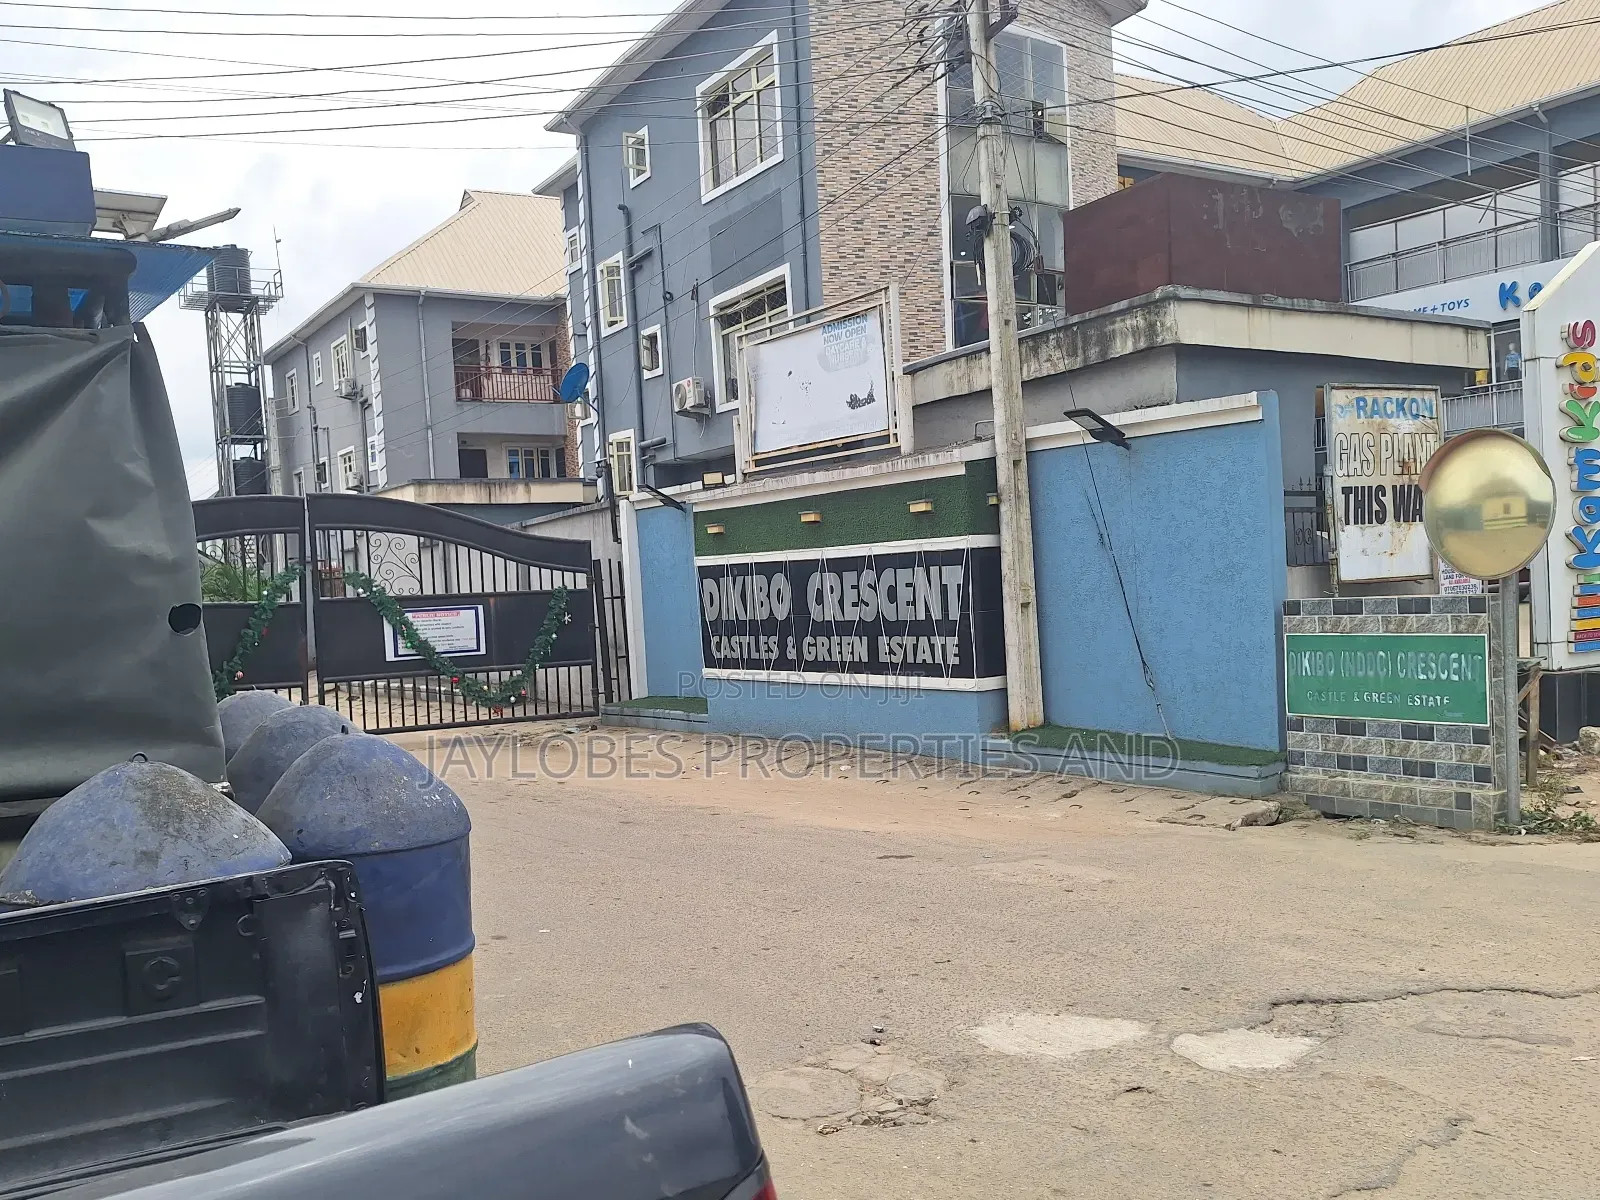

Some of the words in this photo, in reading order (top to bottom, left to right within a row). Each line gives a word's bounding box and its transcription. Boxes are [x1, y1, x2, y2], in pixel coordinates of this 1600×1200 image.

[1441, 298, 1470, 313] TOYS
[822, 313, 868, 335] ADMISSION
[823, 330, 843, 346] NOW
[845, 323, 867, 339] OPEN
[1355, 395, 1434, 420] RACKON
[1334, 431, 1375, 478] GAS
[1341, 484, 1387, 526] THIS
[702, 572, 791, 622] DIKIBO
[806, 565, 962, 622] CRESCENT
[711, 635, 779, 660] CASTLES
[786, 636, 797, 661] &
[802, 636, 868, 663] GREEN
[878, 636, 960, 665] ESTATE
[1396, 651, 1484, 682] CRESCENT
[1306, 690, 1346, 703] CASTLE
[1353, 691, 1360, 702] &
[1363, 691, 1401, 704] GREEN
